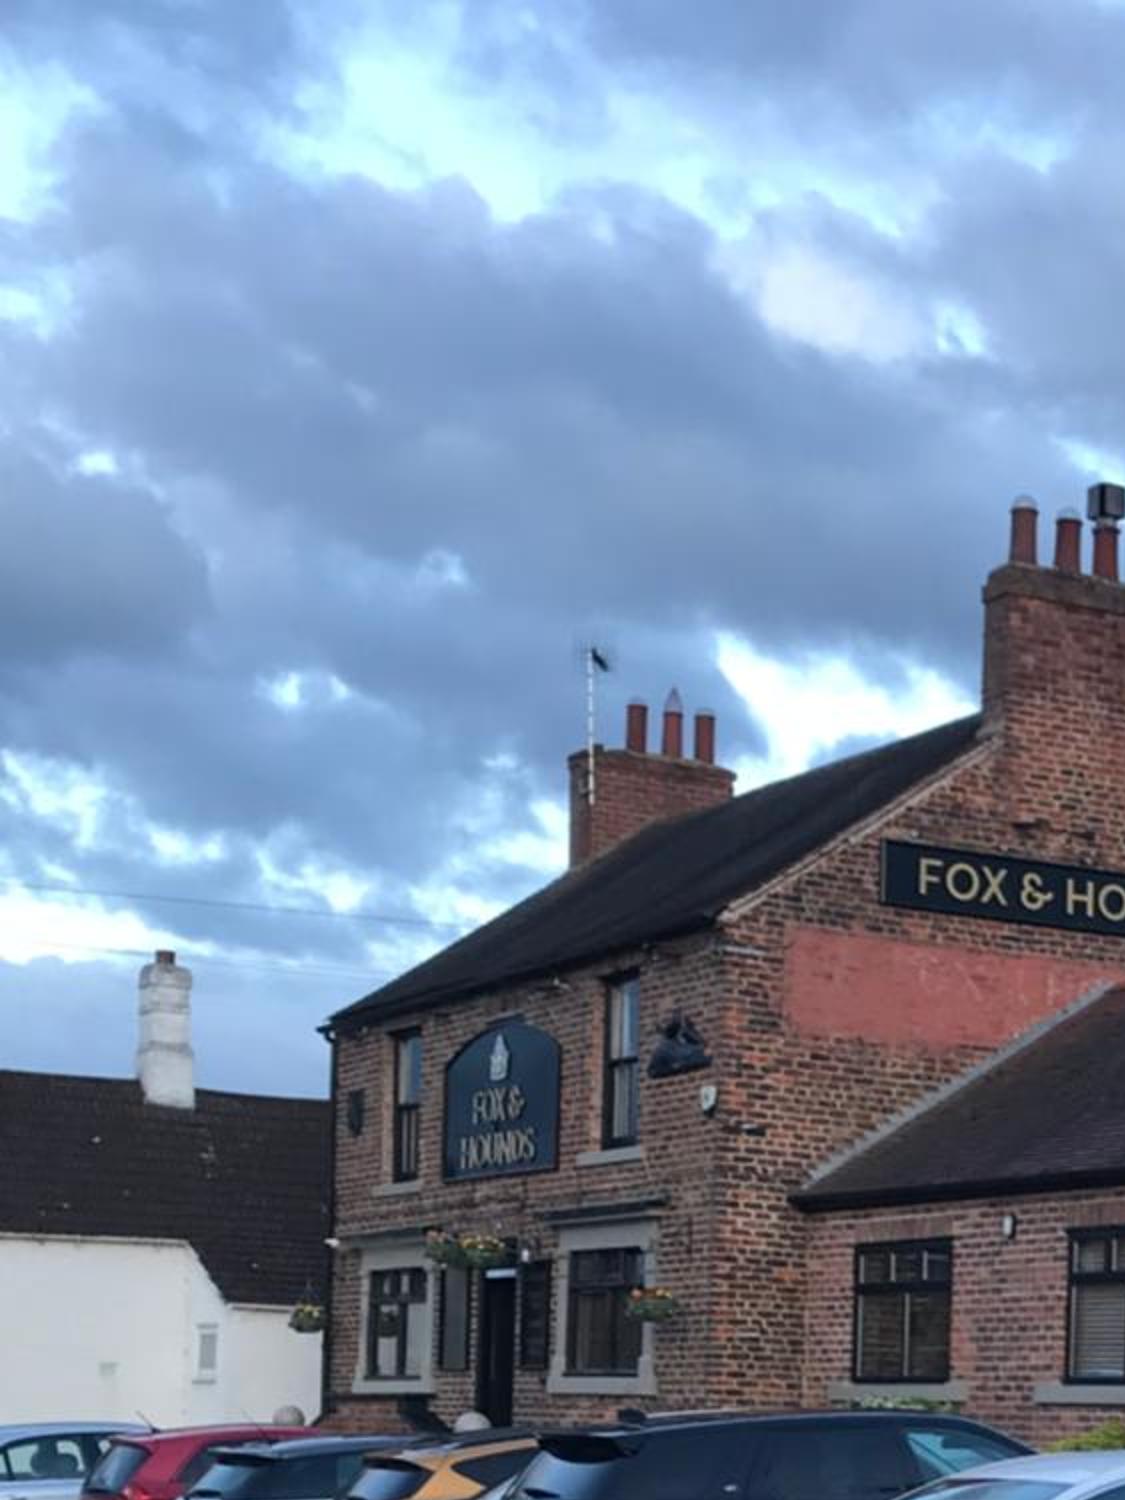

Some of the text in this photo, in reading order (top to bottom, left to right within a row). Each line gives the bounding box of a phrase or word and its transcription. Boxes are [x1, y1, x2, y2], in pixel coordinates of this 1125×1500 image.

[918, 857, 1007, 906] FOX
[1020, 872, 1053, 910] &
[472, 1084, 525, 1125] FOX &
[460, 1126, 535, 1170] HOUNDS
